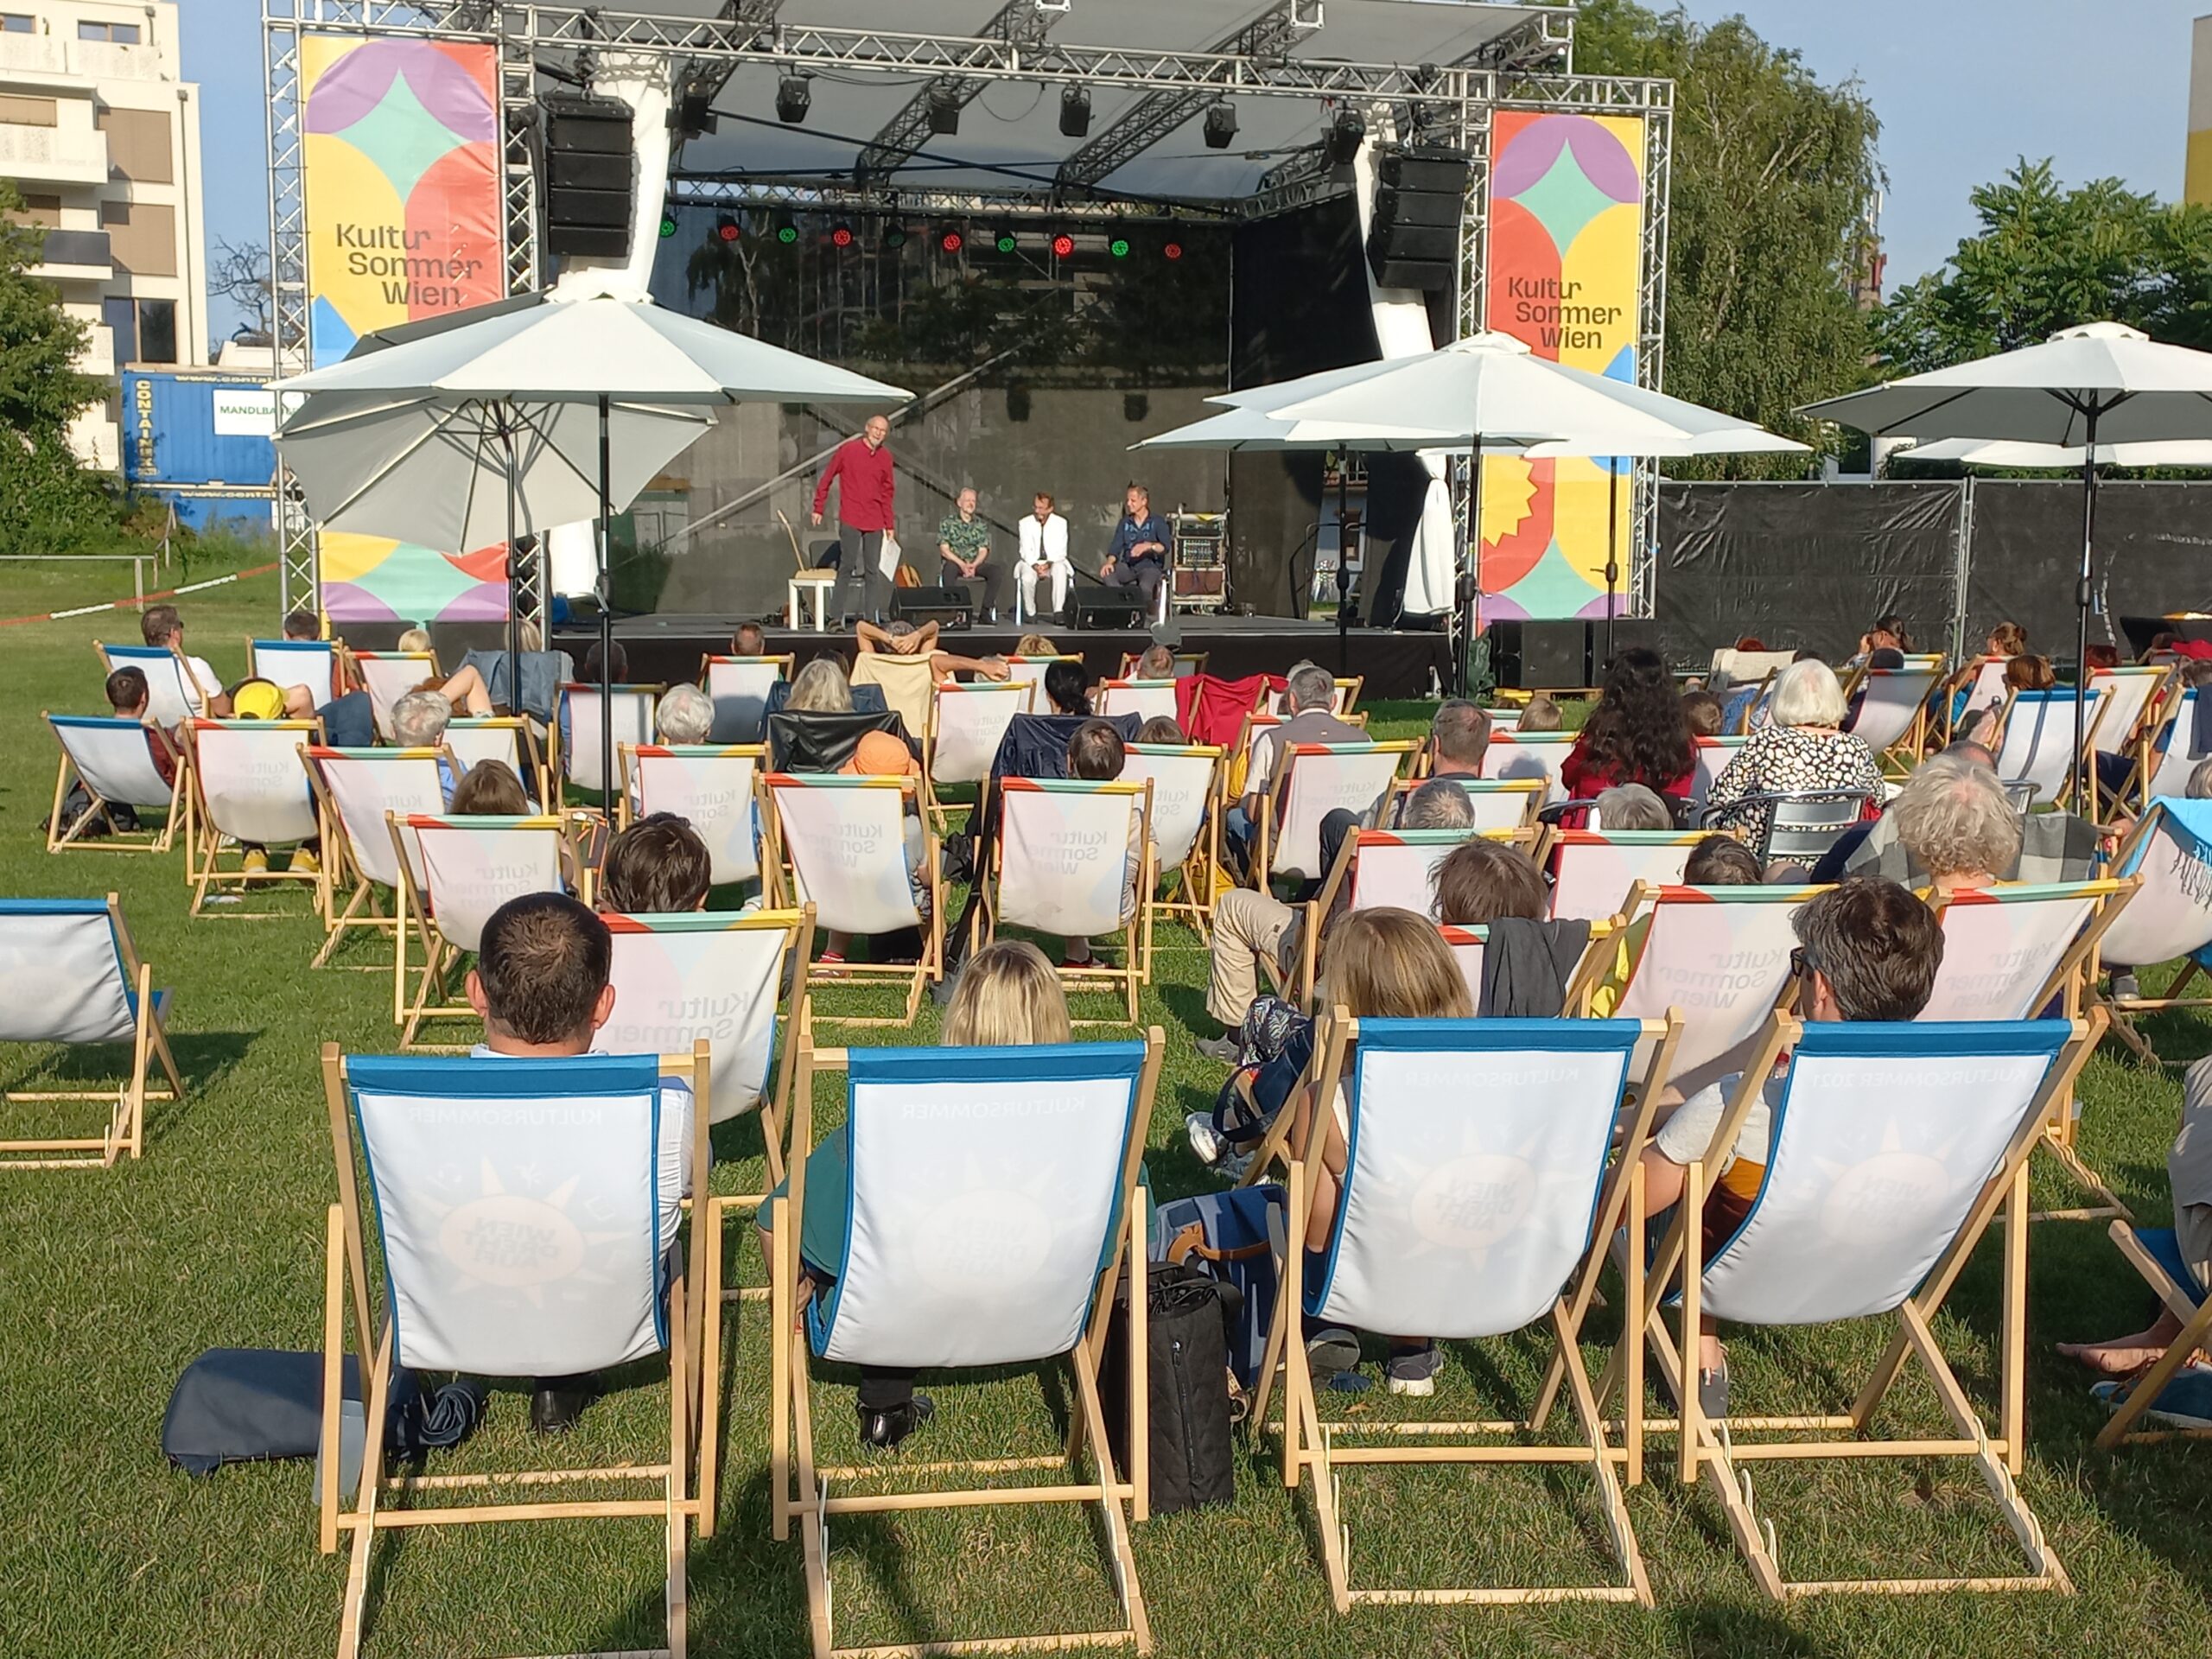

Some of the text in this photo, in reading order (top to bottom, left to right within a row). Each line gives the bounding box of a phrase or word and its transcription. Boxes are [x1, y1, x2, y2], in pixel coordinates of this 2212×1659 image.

[336, 224, 430, 250] Kultur
[348, 252, 483, 279] Sommer
[382, 281, 461, 307] Wien
[1509, 276, 1582, 299] Kultur
[1516, 302, 1622, 325] Sommer
[1541, 326, 1602, 349] Wien
[136, 379, 154, 467] CONTAINEX
